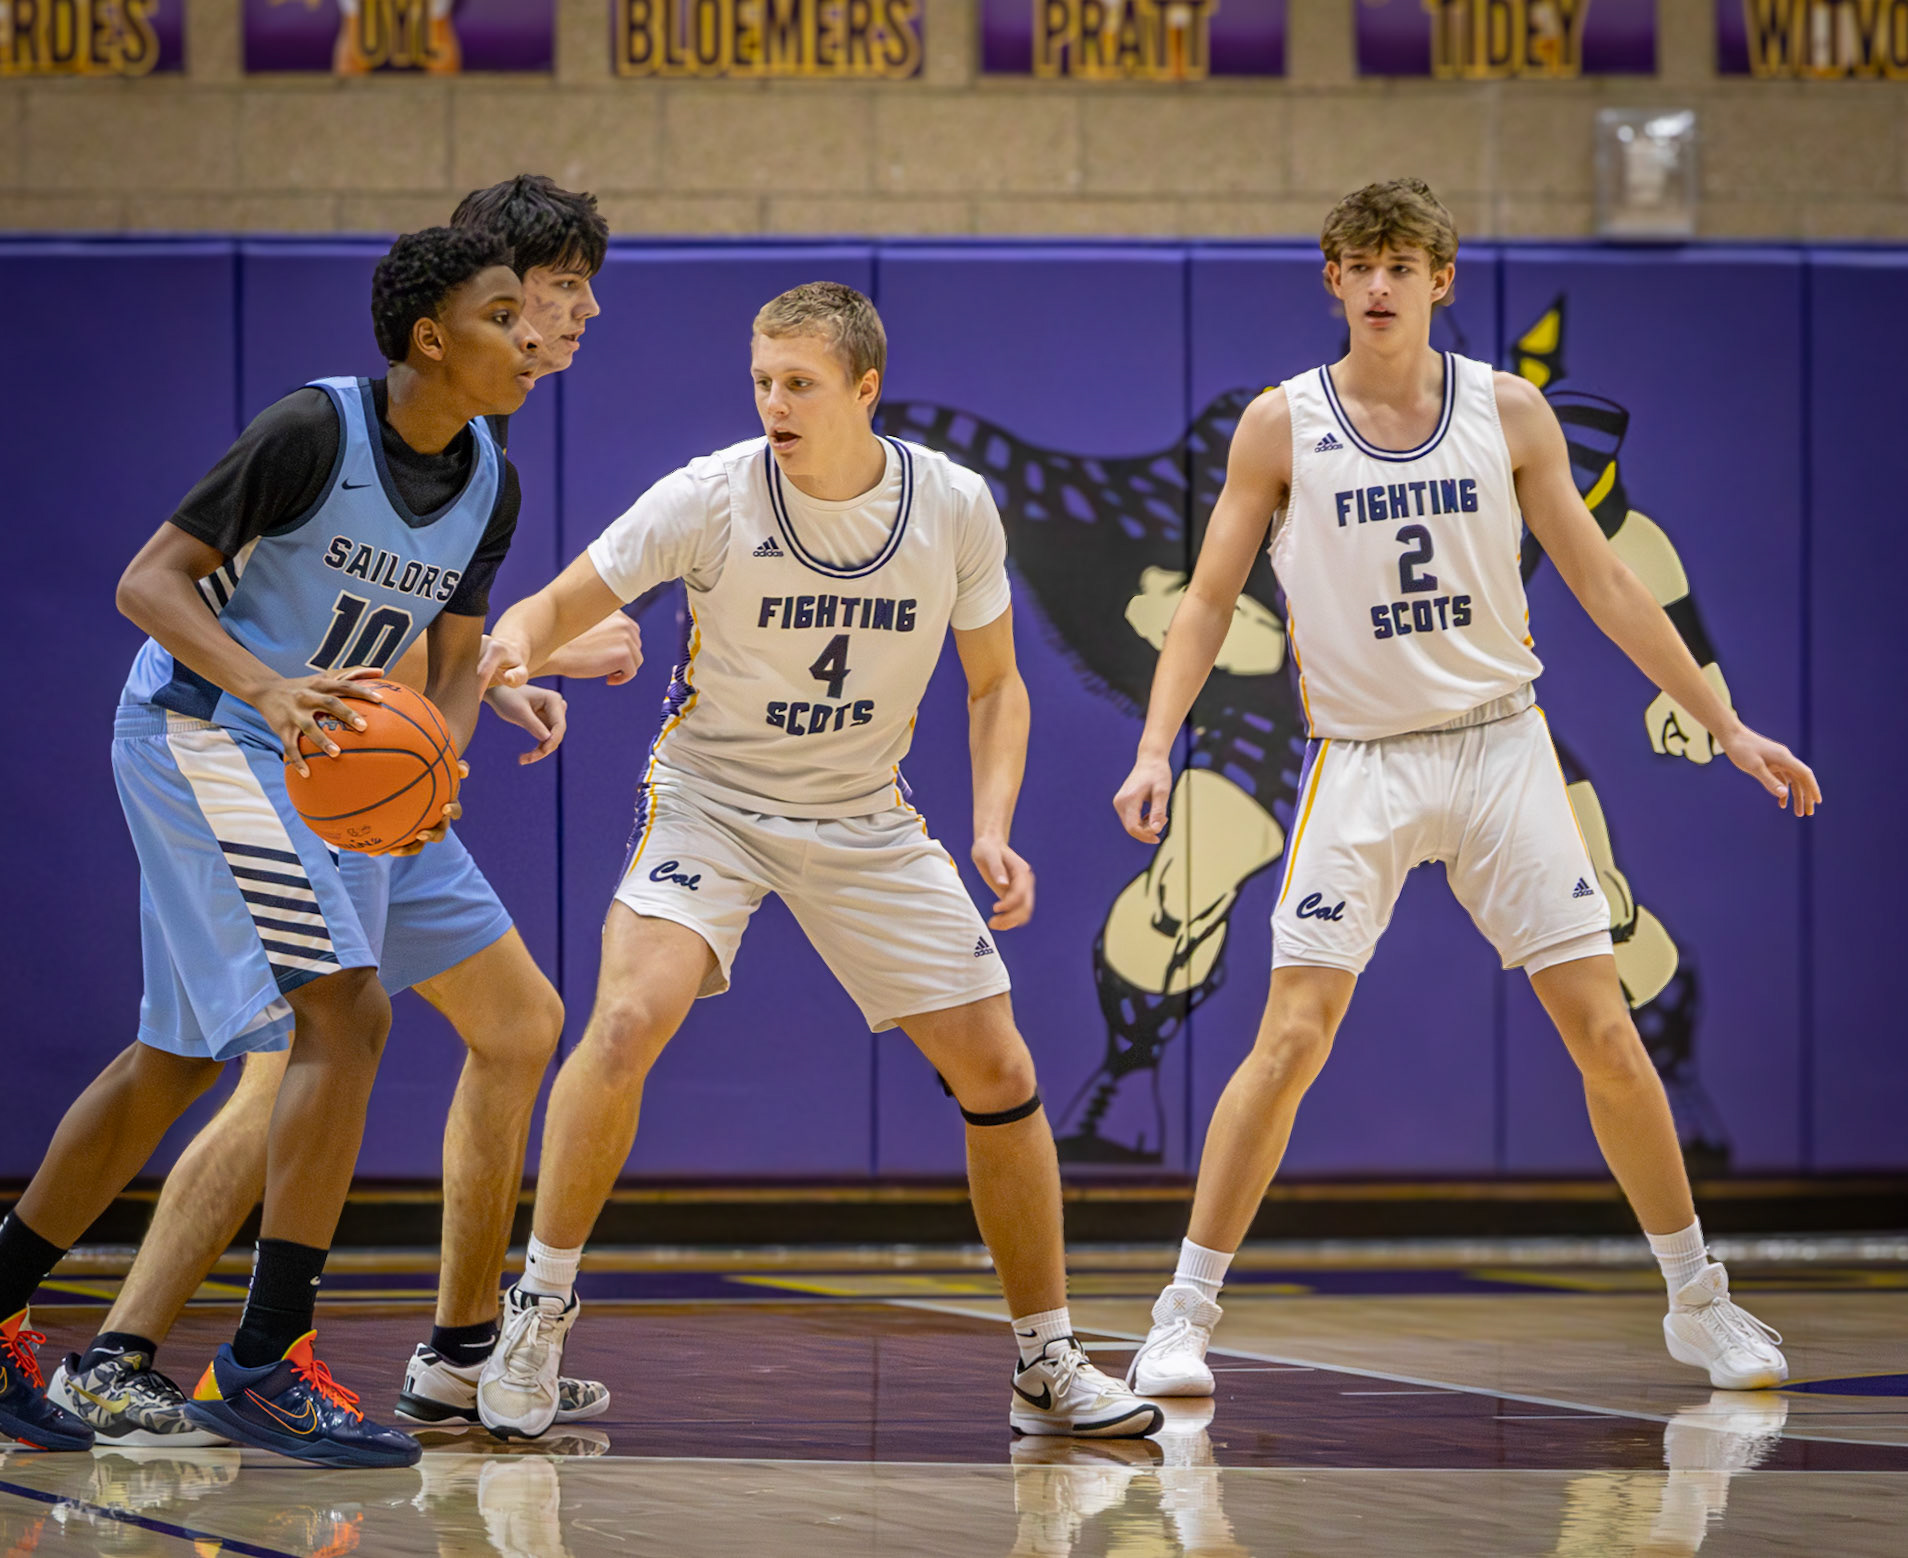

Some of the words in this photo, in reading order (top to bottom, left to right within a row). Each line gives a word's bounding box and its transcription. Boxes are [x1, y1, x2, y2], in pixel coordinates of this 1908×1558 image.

[624, 0, 914, 67] BLOEMERS
[1042, 0, 1206, 68] PRATT
[1433, 0, 1581, 68] TIDEY
[1334, 478, 1479, 527] FIGHTING
[323, 535, 462, 602] SAILORS
[752, 549, 784, 558] adidas
[1395, 524, 1438, 594] 2
[305, 589, 413, 671] 10
[757, 594, 918, 632] FIGHTING
[1370, 595, 1472, 640] SCOTS
[808, 634, 852, 699] 4
[765, 699, 875, 736] SCOTS
[649, 860, 702, 891] Cal
[1296, 891, 1346, 922] Cal
